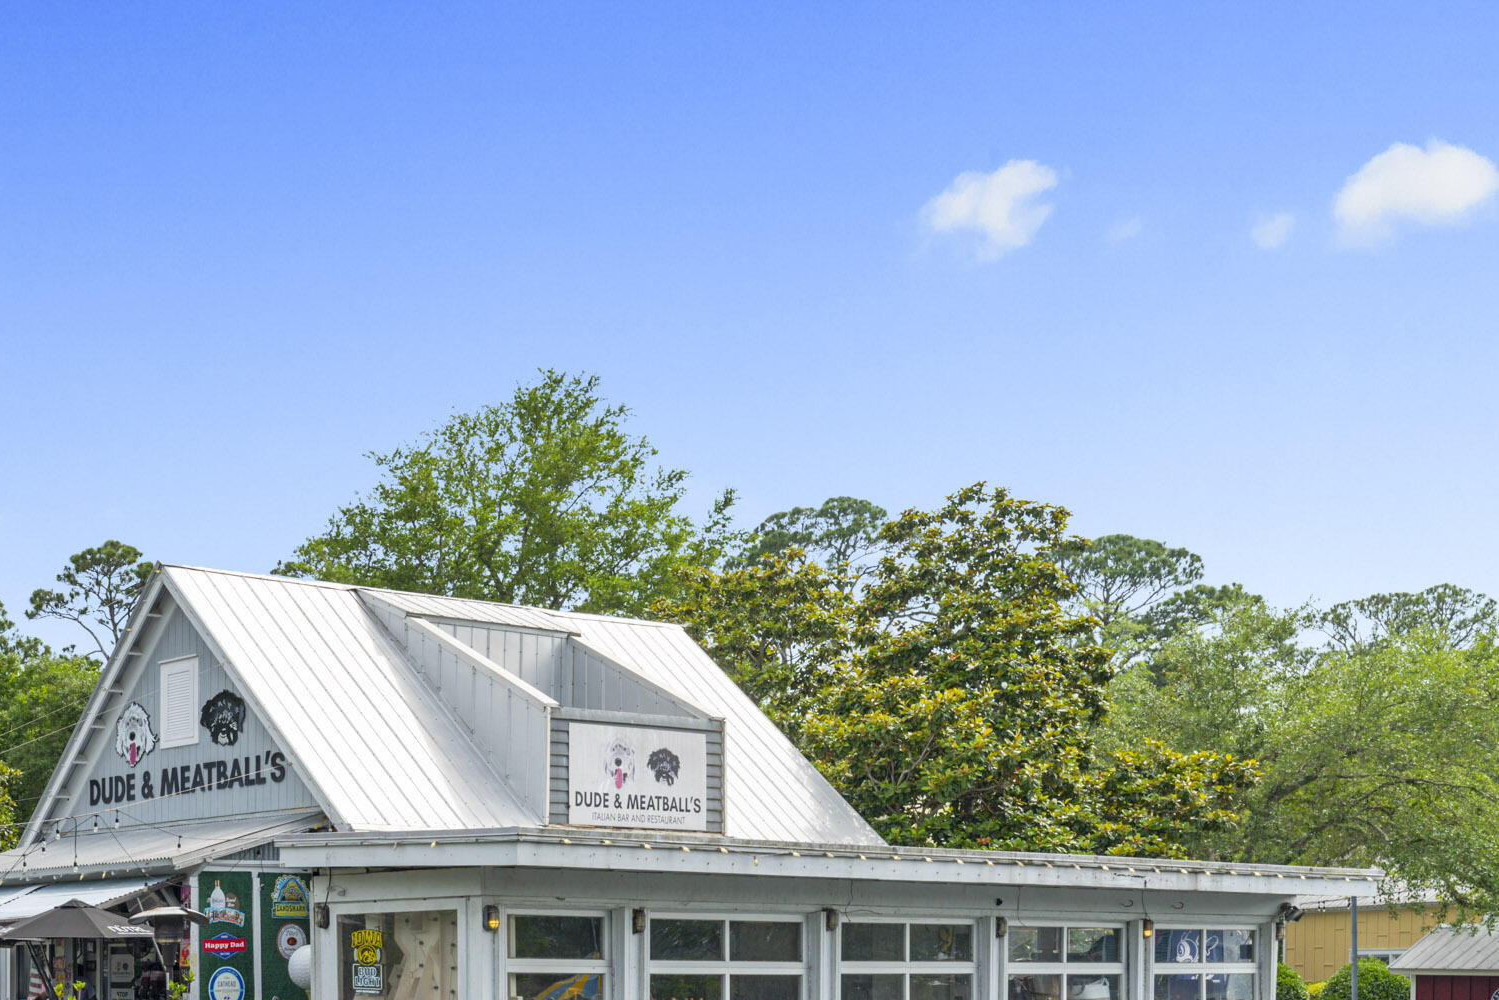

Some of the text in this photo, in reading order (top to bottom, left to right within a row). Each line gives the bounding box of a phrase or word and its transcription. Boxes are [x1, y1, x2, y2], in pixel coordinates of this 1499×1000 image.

[89, 750, 286, 806] DUDE & MEATBALL'S
[575, 791, 701, 813] DUDE & MEATBALL'S
[592, 812, 685, 825] ITALIAN BAR AND RESTAURANT
[351, 929, 382, 948] IOWA
[204, 942, 229, 950] Happy
[357, 966, 377, 977] BUD
[354, 976, 381, 987] LIGHT
